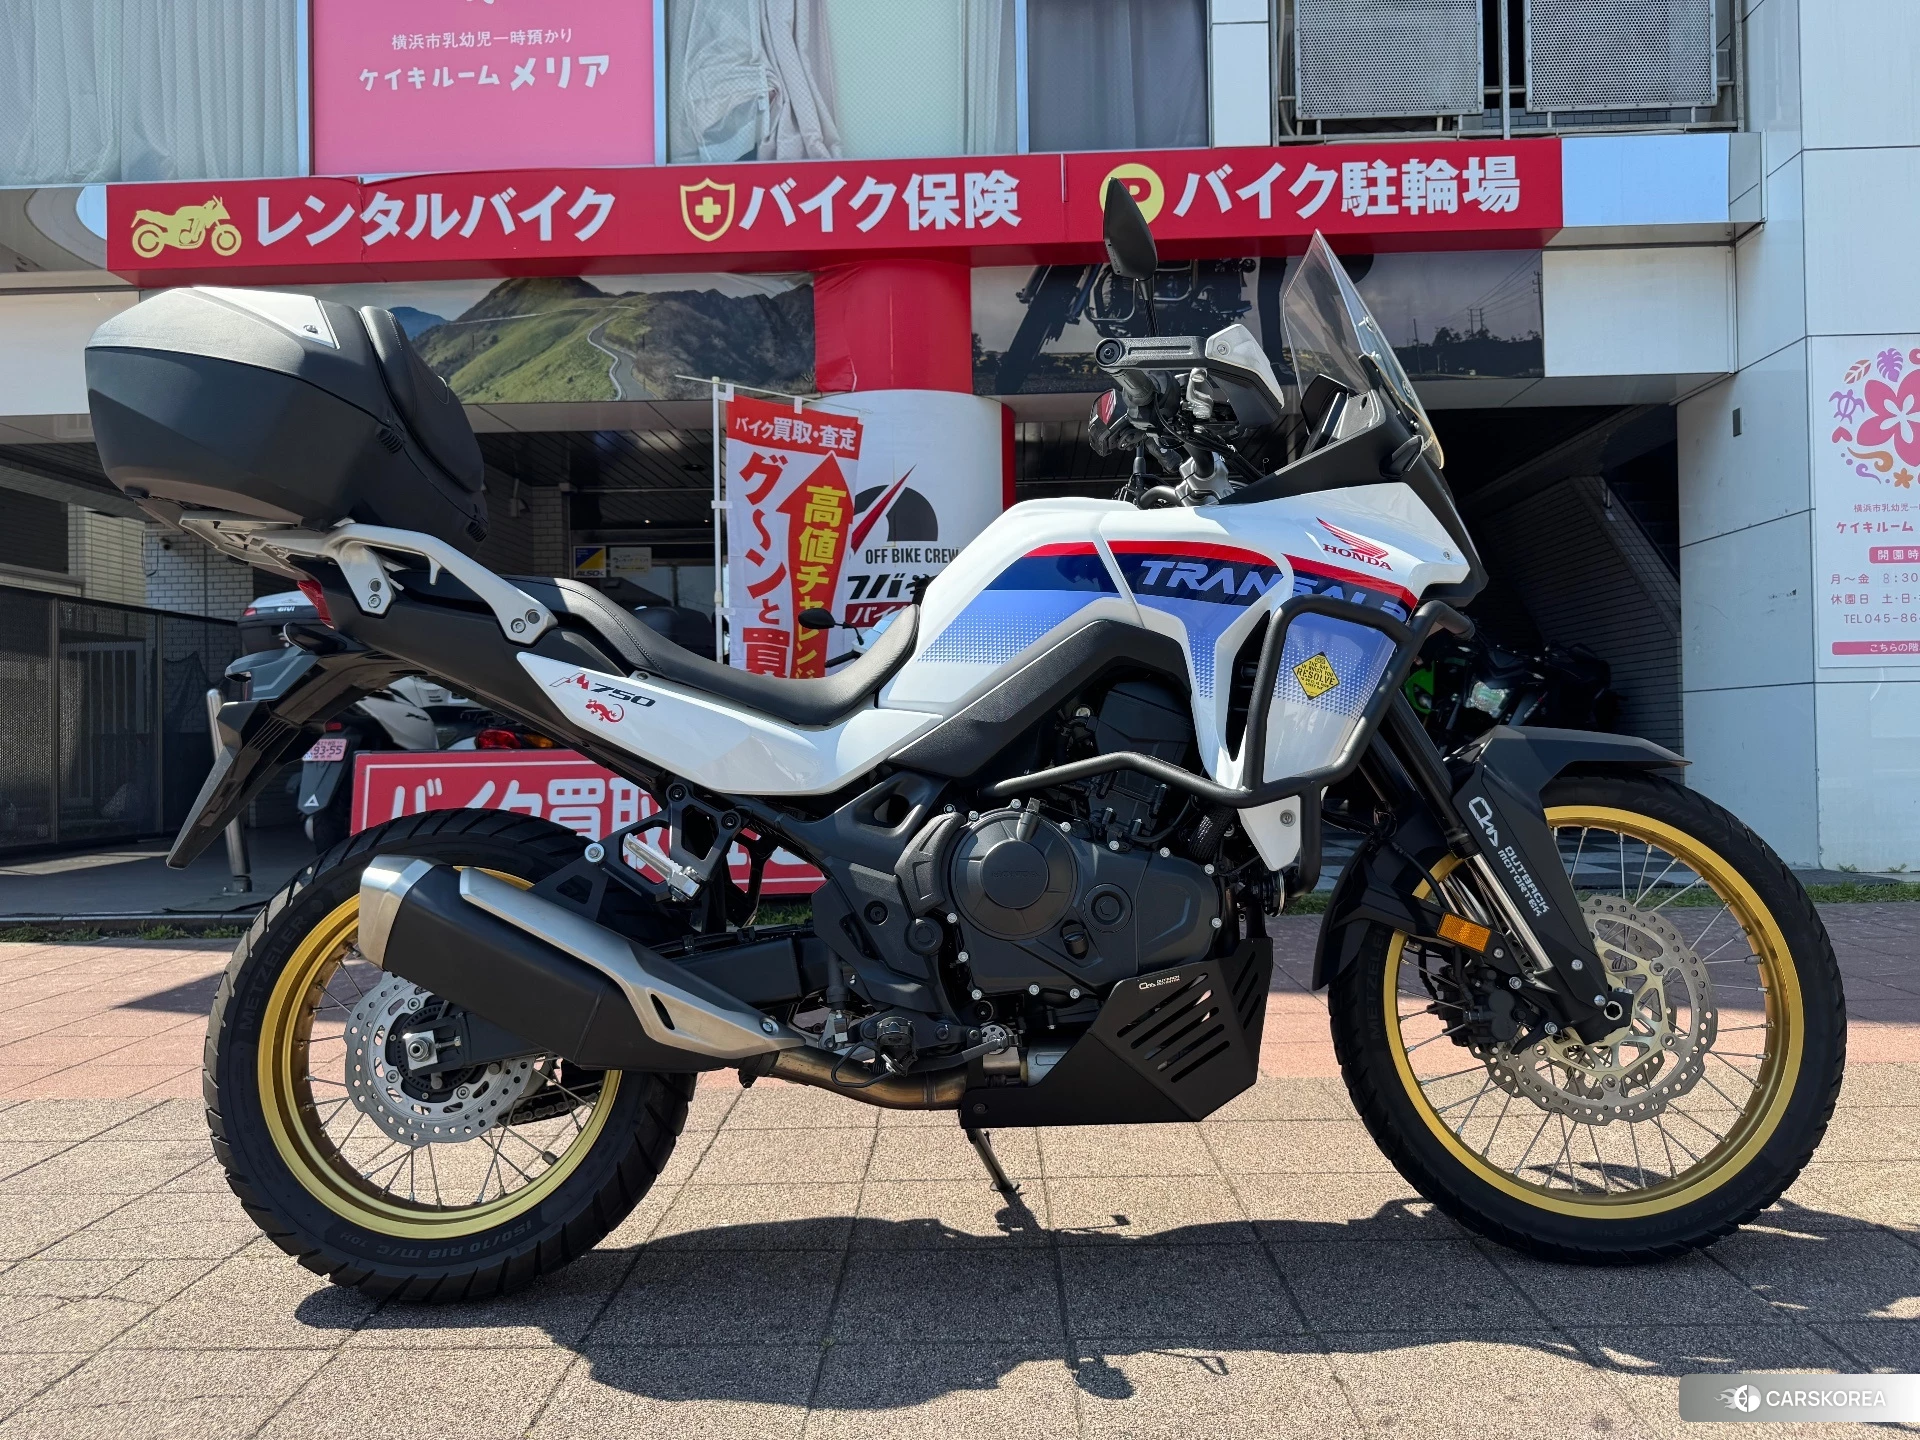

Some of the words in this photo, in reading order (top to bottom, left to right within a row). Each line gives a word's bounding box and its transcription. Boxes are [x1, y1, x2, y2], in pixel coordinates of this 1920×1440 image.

[392, 28, 572, 50] 横浜市乳幼児一時預かり
[359, 65, 500, 91] ケイキルーム
[510, 55, 609, 91] メリア
[1173, 155, 1520, 220] バイク駐輪場
[738, 170, 1021, 233] バイク保険
[257, 186, 616, 247] レンタルバイク
[1854, 503, 1920, 513] 横浜市乳幼児一
[1836, 521, 1914, 534] ケイキルーム
[865, 548, 888, 564] OFF
[892, 547, 922, 563] BIKE
[924, 547, 960, 563] CREW
[1323, 543, 1393, 572] HONDA
[1882, 592, 1920, 604] 土・日・
[1844, 613, 1920, 624] TEL045-86
[1870, 642, 1920, 653] こちらの階
[1297, 667, 1335, 686] RESOLVE
[591, 682, 656, 708] 750
[313, 745, 343, 755] 93-55
[1498, 849, 1544, 917] MOTORTEK
[1504, 845, 1550, 913] OUTBACK
[238, 914, 309, 1031] METZELER
[469, 1220, 532, 1253] 150/70
[427, 1246, 464, 1259] R18
